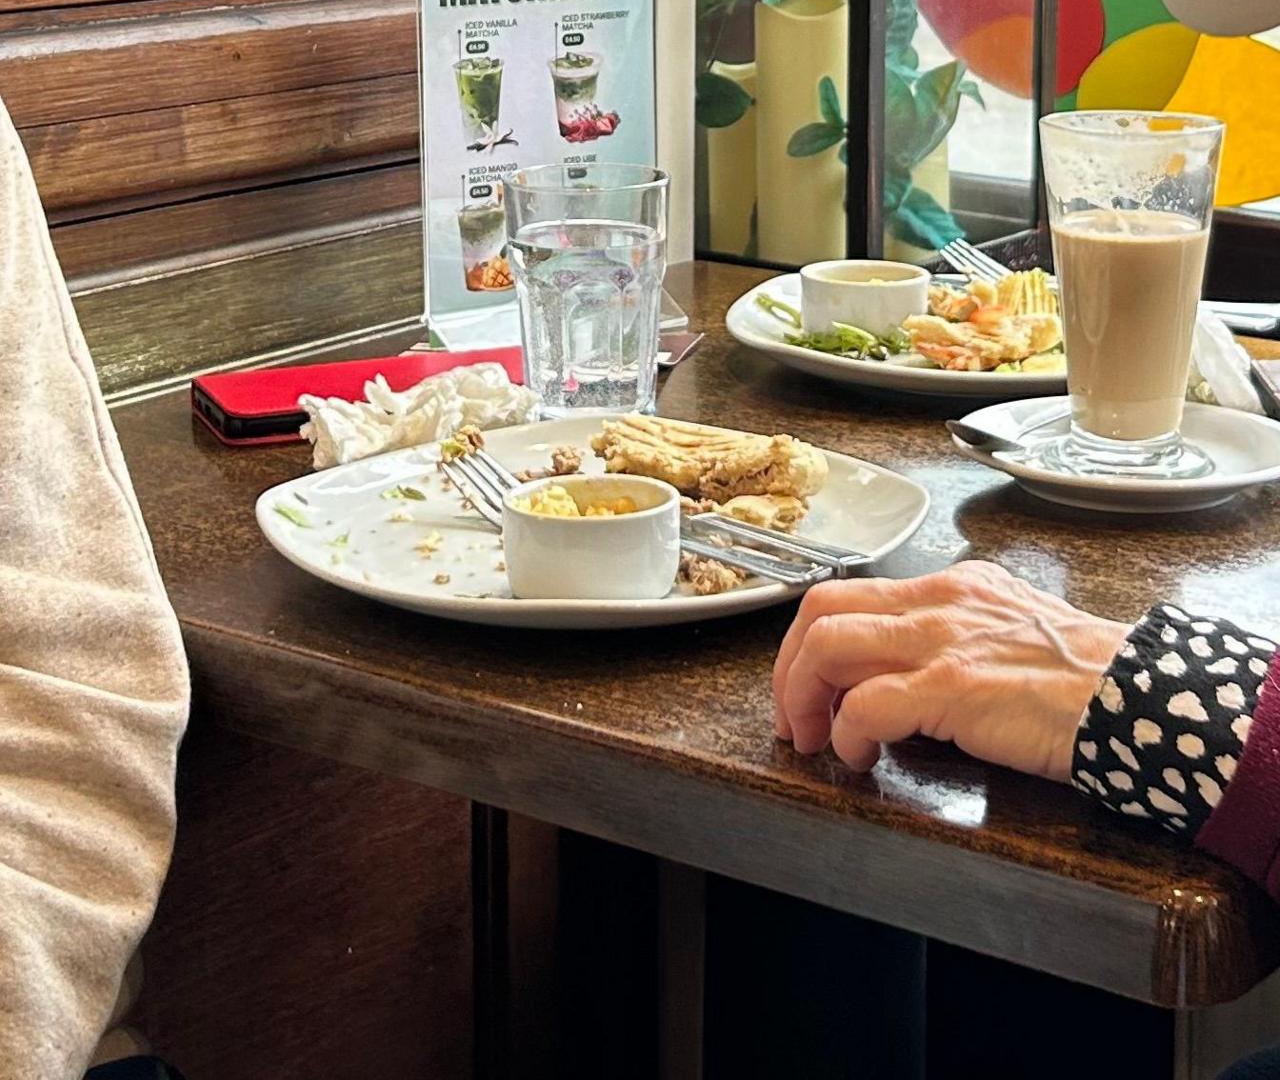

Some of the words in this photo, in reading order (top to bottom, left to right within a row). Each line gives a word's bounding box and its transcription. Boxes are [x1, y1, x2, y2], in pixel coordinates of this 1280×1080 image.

[562, 14, 580, 22] ICED
[465, 21, 484, 29] ICED
[485, 19, 518, 28] VANILLA
[562, 22, 594, 31] MATCHA
[465, 29, 500, 38] MATCHA
[468, 166, 487, 175] ICED
[488, 163, 518, 173] MANGO
[468, 175, 503, 183] MATCHA
